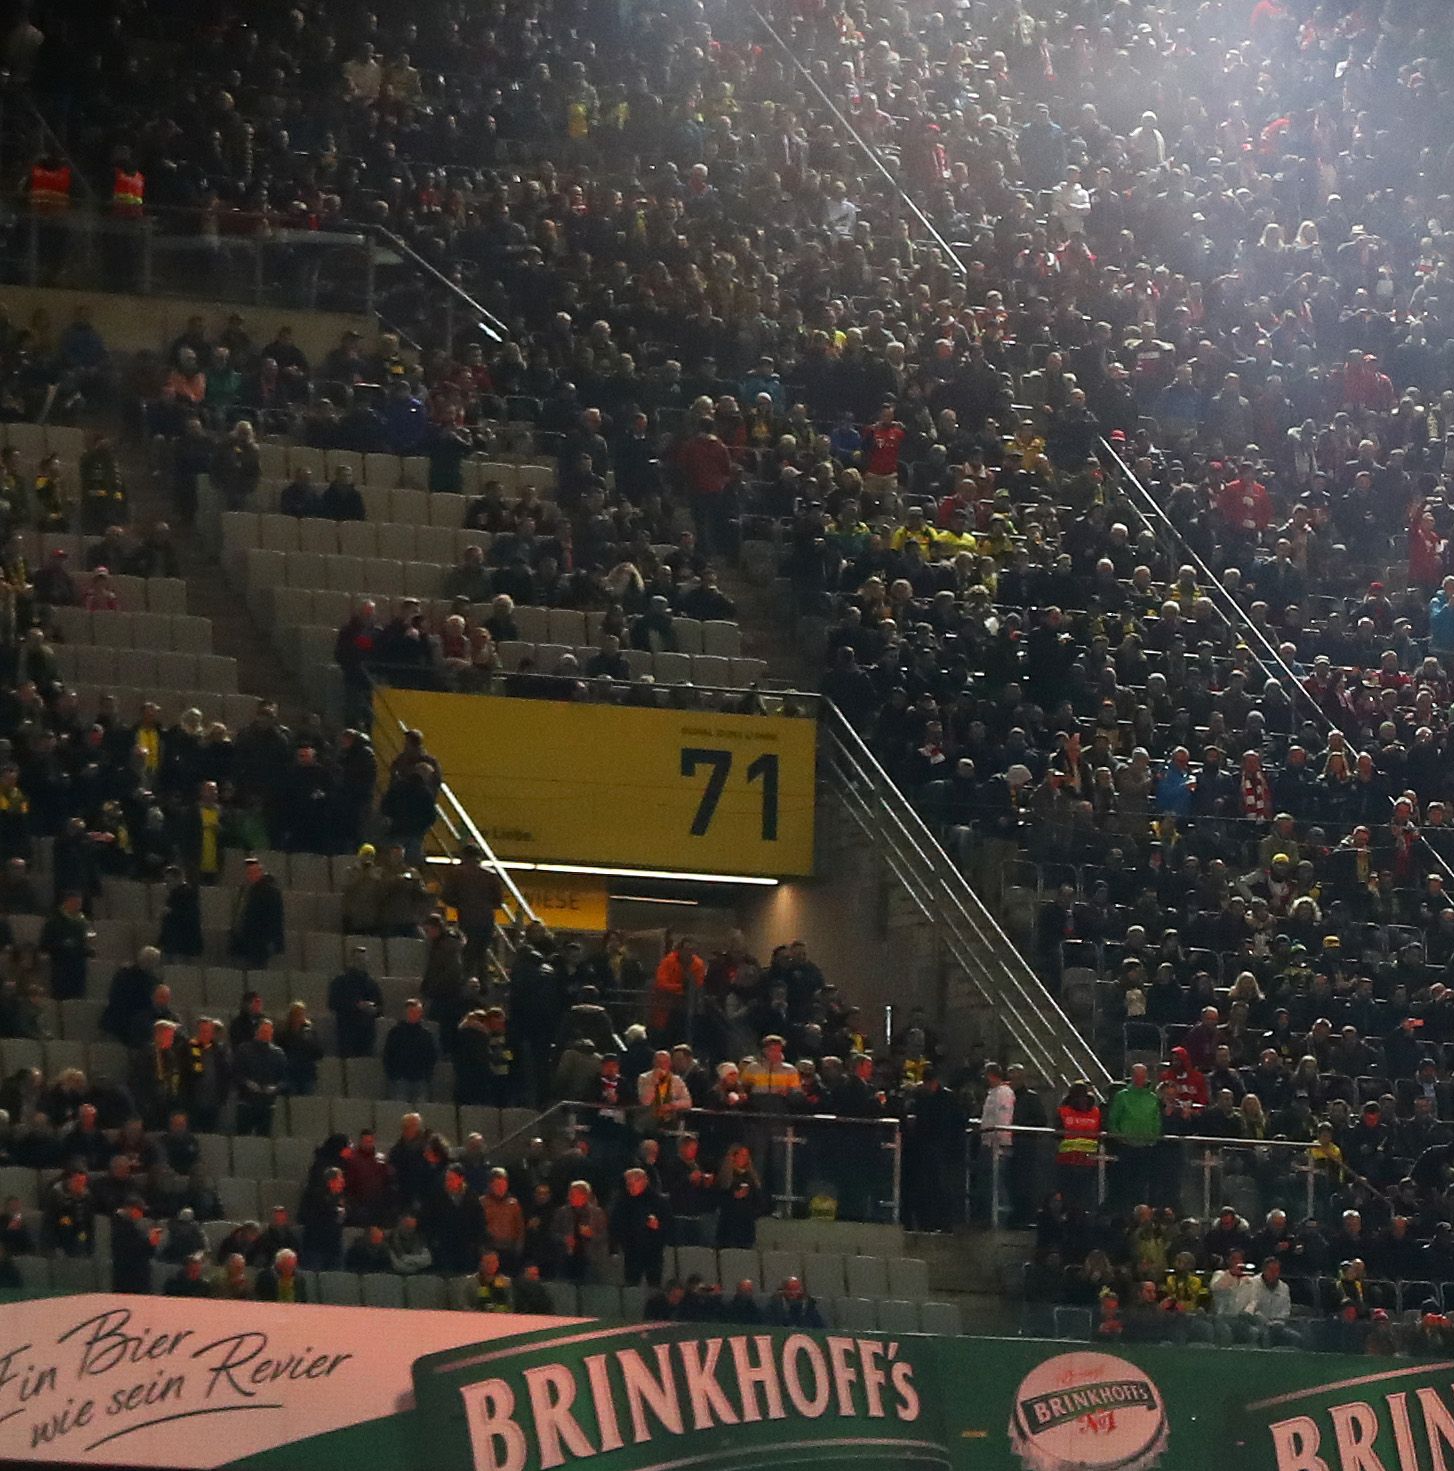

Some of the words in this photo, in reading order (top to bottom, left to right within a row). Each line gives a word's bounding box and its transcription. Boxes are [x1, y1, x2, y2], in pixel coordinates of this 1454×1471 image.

[681, 747, 779, 841] 71
[31, 1398, 95, 1448] wie
[106, 1368, 186, 1415] sein
[192, 1331, 353, 1398] Revier
[58, 1308, 195, 1380] Bier
